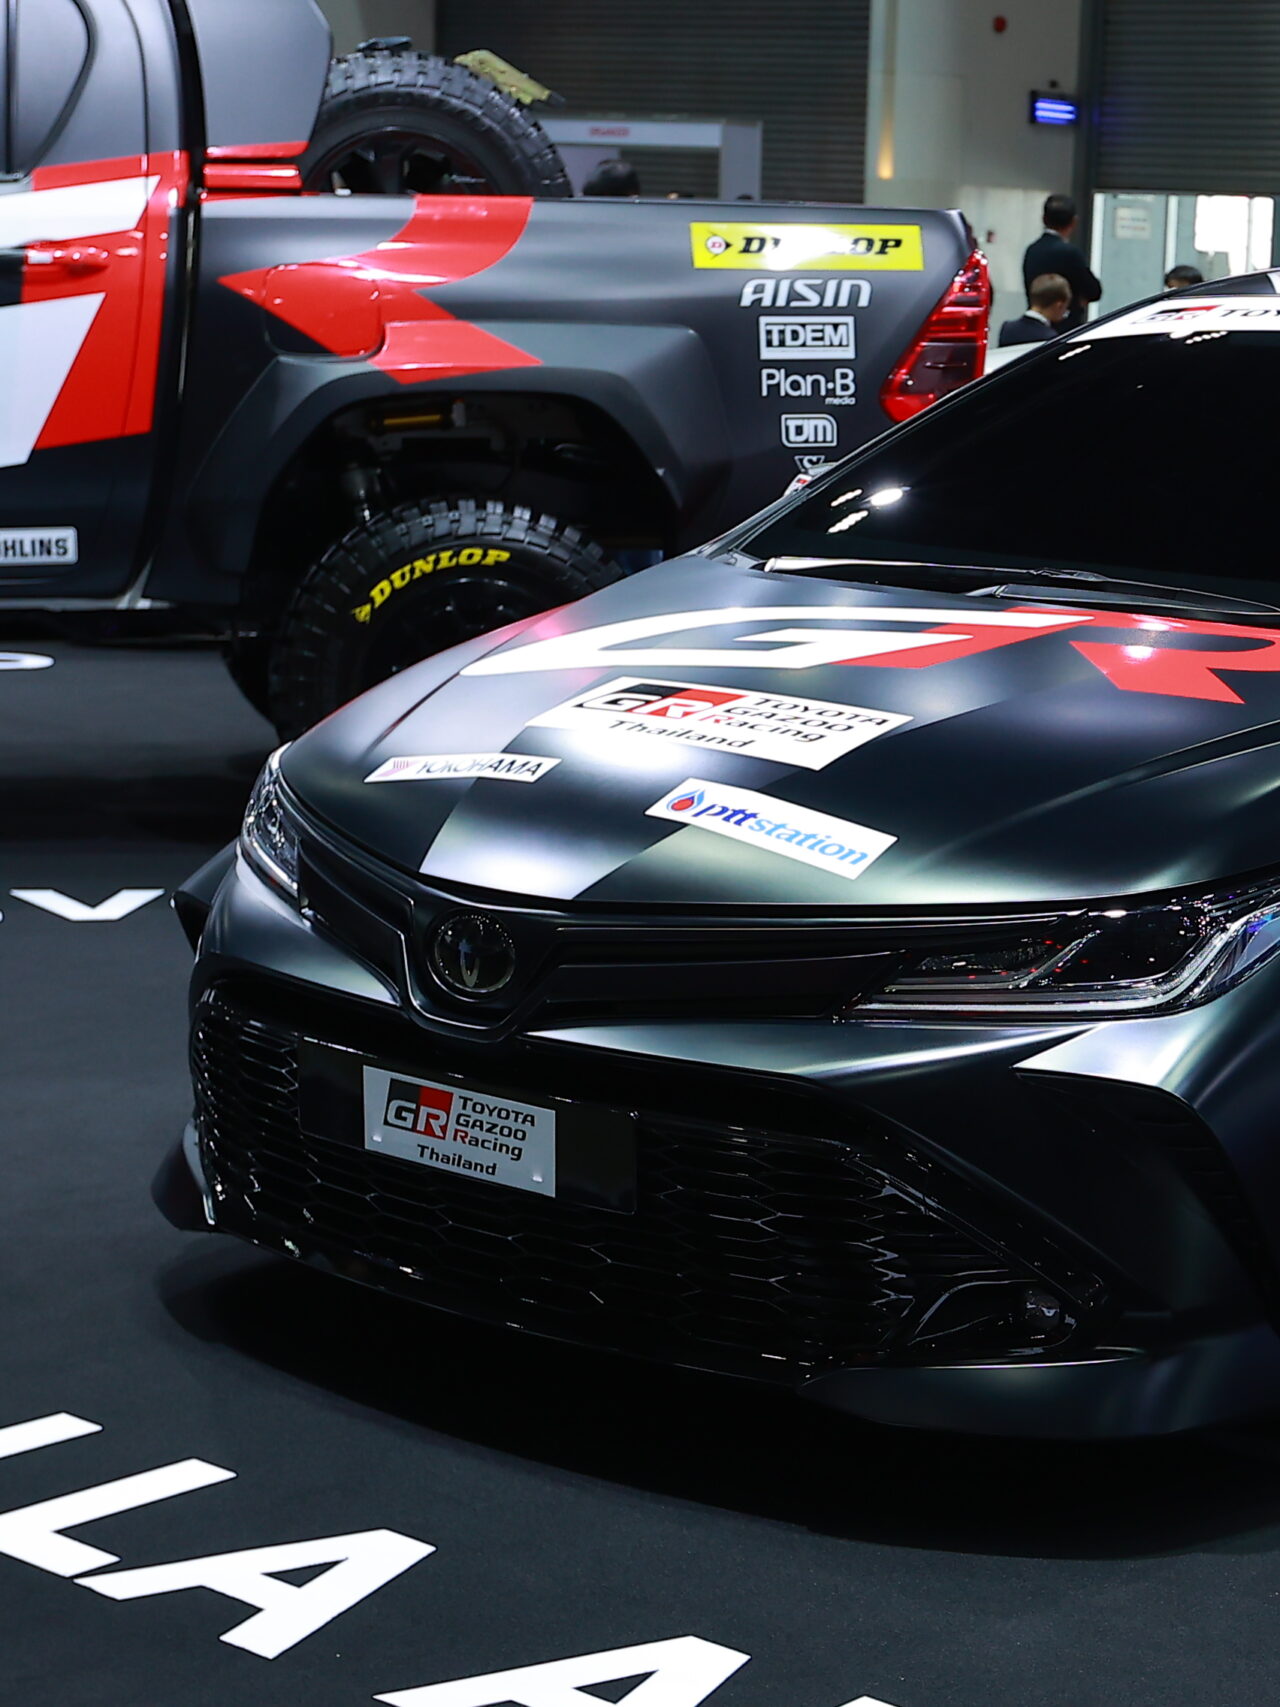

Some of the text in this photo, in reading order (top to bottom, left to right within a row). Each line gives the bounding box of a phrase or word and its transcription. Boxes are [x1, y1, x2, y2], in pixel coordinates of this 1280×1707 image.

[738, 236, 902, 256] DOP
[739, 278, 872, 308] AISIN
[765, 323, 848, 347] TDEM
[1, 538, 68, 557] HLINS
[370, 547, 511, 608] DUNLOP
[723, 706, 854, 733] GAZOO
[755, 698, 891, 727] TOYOTA
[609, 720, 756, 749] Thailand
[699, 715, 827, 743] Racing
[416, 758, 544, 777] YOKOHAMA
[386, 1099, 448, 1138] GR
[459, 1095, 536, 1127] TOYOTA
[455, 1112, 527, 1142] GAZOO
[417, 1143, 497, 1176] Thailand
[453, 1128, 523, 1162] Racing
